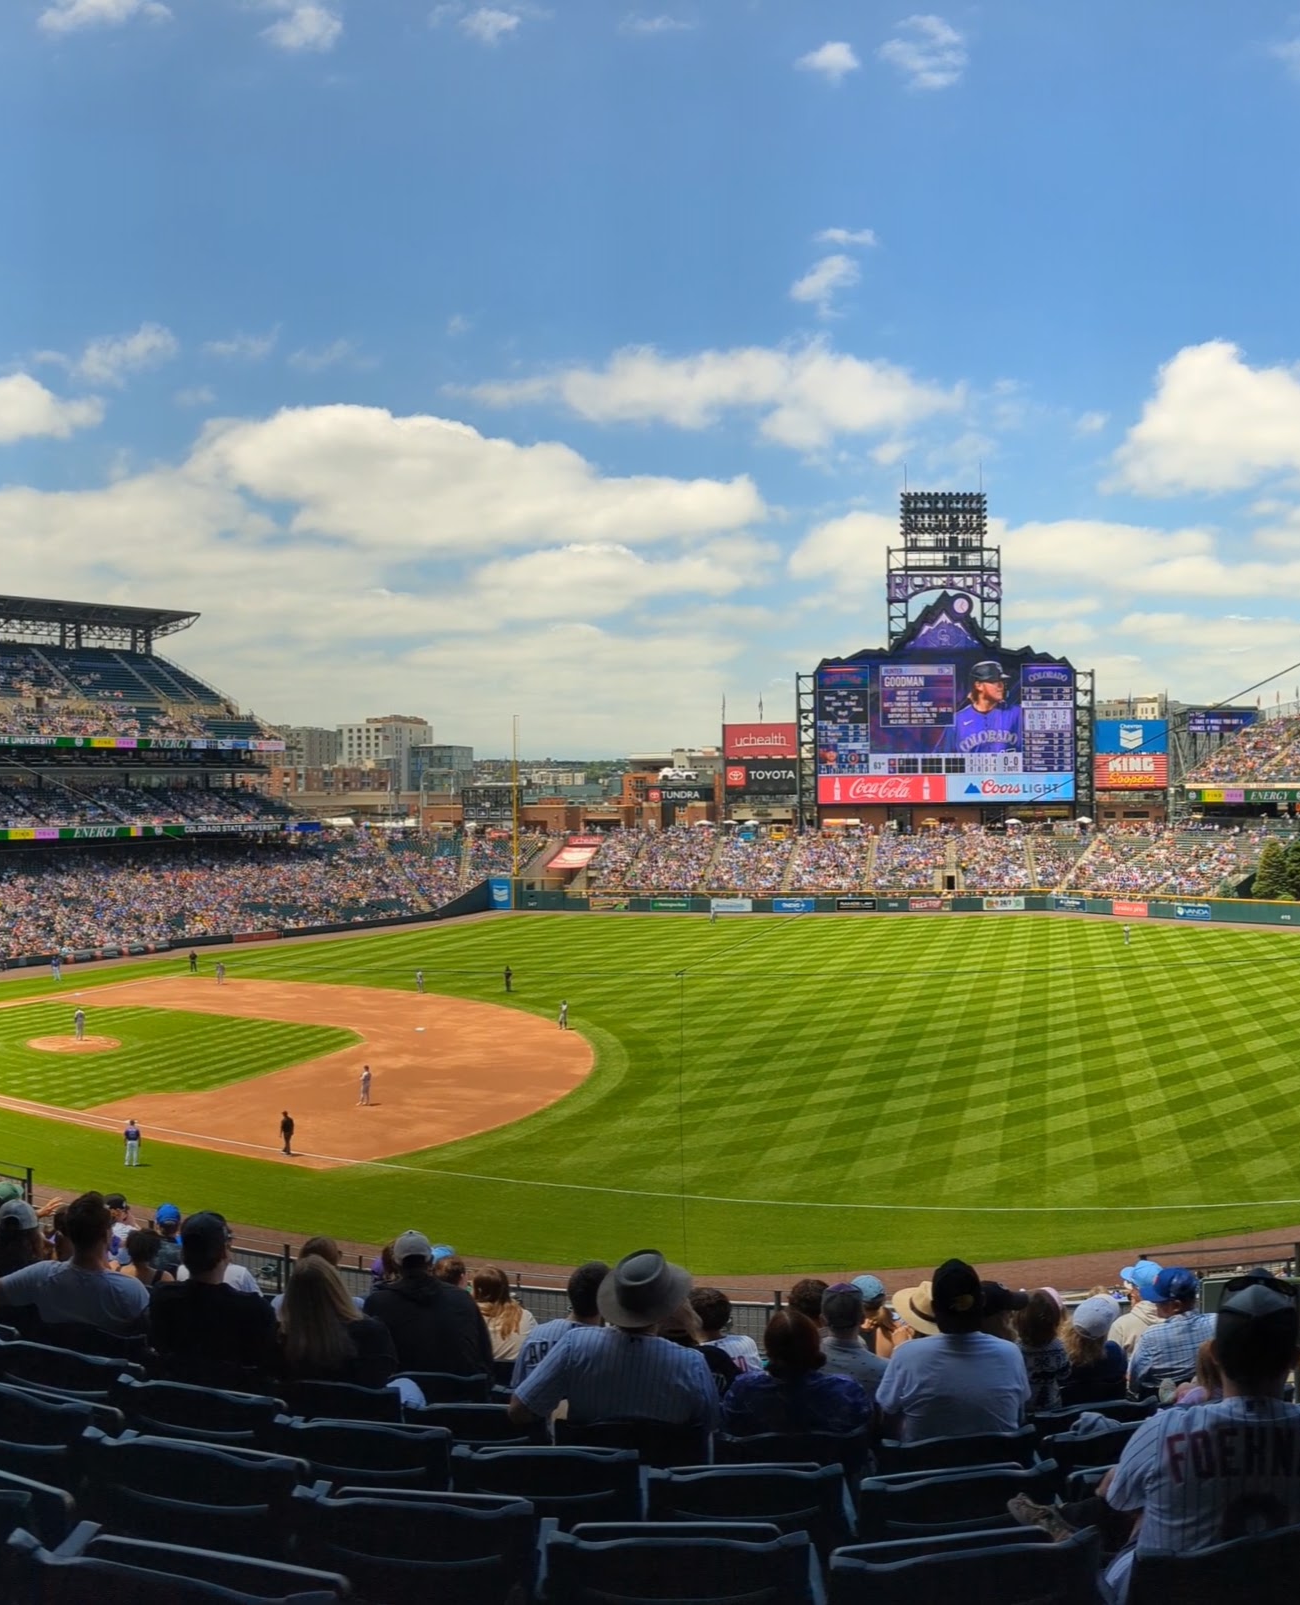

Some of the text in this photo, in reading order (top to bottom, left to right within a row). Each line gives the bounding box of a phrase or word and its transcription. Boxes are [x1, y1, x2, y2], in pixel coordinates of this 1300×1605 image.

[884, 676, 925, 688] GOODMAN
[1028, 670, 1068, 683] COLORADO
[11, 736, 58, 746] UNIVERSITY
[149, 739, 190, 749] ENERGY
[734, 732, 787, 747] uchealth
[959, 729, 1019, 753] COLORADO
[1108, 757, 1155, 772] KING
[749, 769, 796, 781] TOYOTA
[1108, 772, 1155, 786] Soopers
[848, 777, 913, 799] Coca-Cola
[981, 778, 1060, 795] Coors LIGHT
[661, 790, 700, 799] TUNDRA
[1250, 791, 1290, 801] ENERGY
[73, 826, 118, 839] ENERGY
[184, 824, 281, 834] COLORADO STATE UNIVERSITY
[910, 900, 942, 910] TREE TOP
